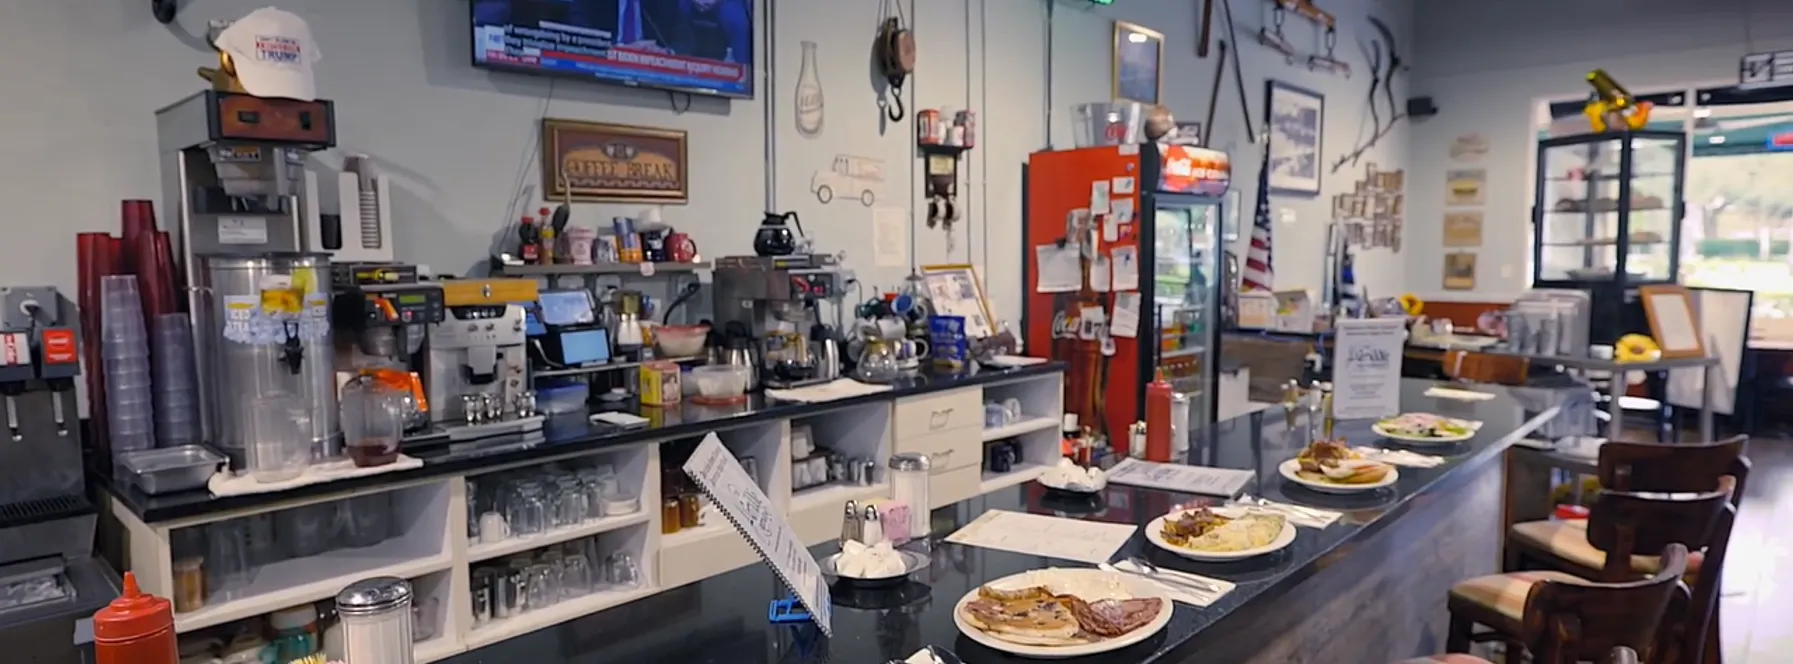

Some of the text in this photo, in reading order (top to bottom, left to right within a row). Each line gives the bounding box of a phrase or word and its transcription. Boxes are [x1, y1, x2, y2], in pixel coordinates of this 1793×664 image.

[262, 50, 297, 62] TRUMP
[565, 159, 674, 180] COFFEE BREAK
